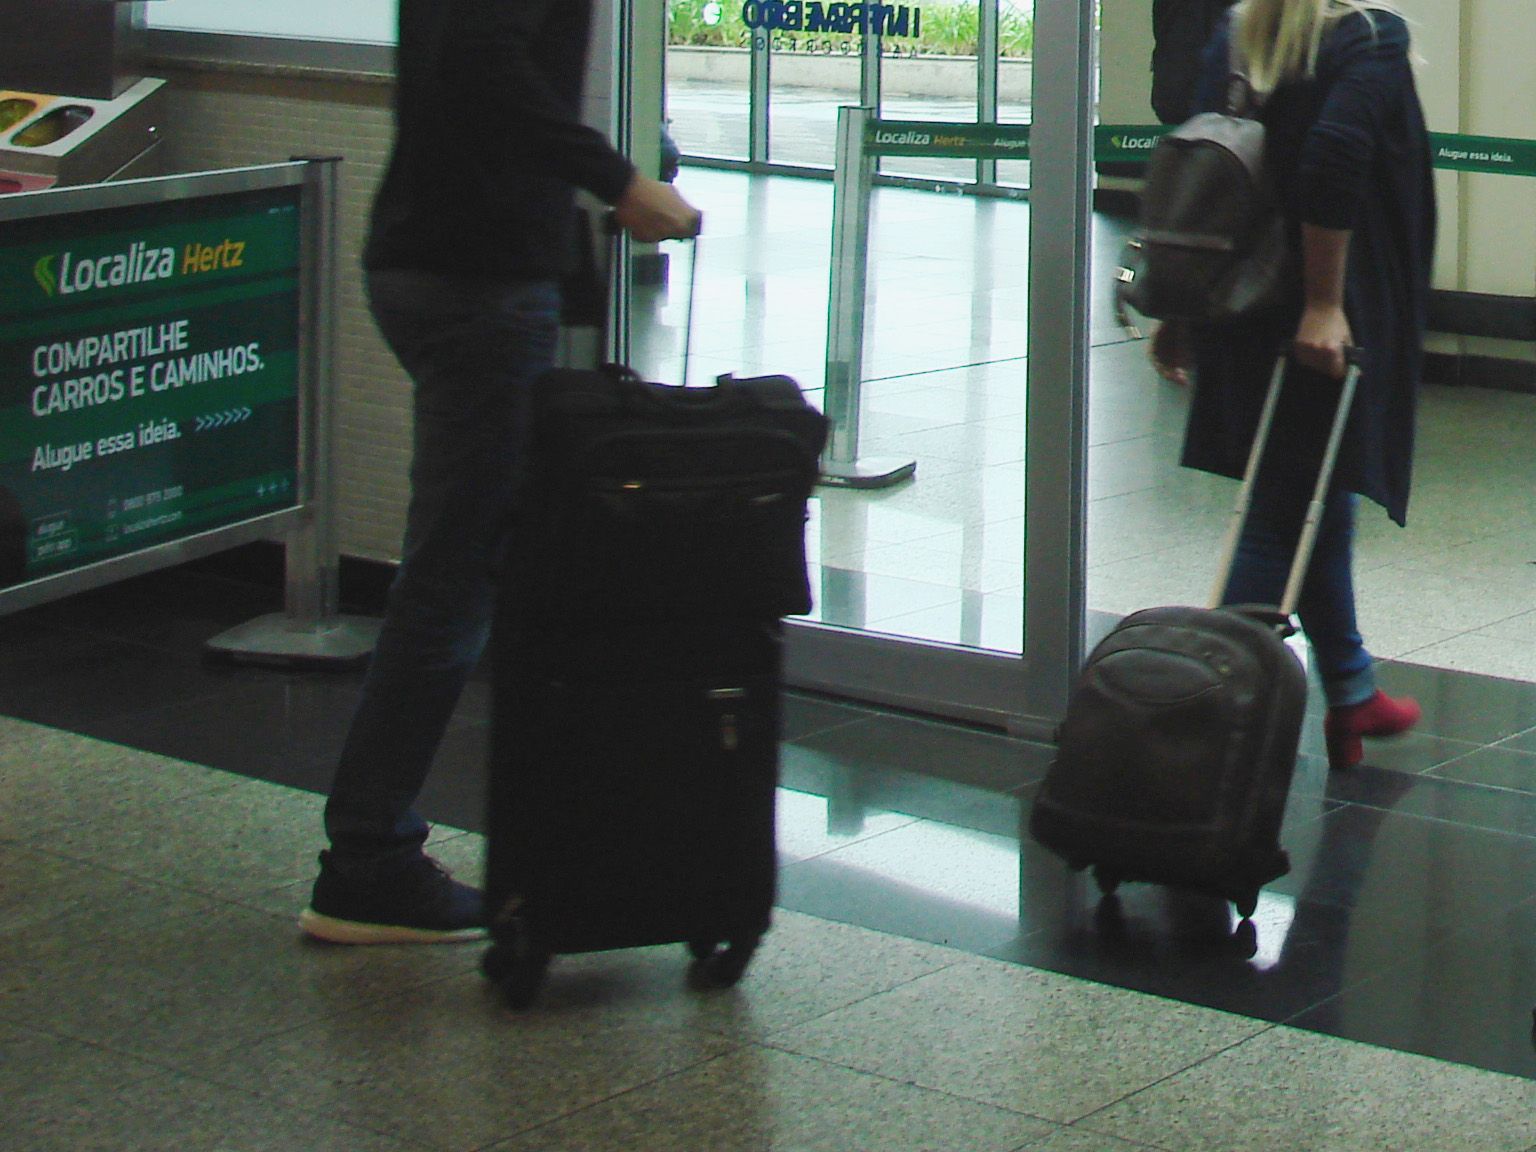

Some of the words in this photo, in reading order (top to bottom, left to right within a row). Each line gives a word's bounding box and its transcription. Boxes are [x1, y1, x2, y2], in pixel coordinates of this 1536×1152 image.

[875, 130, 930, 145] Localiza
[933, 134, 965, 147] Hertz
[1121, 135, 1160, 149] Locali
[1438, 147, 1468, 160] Alugue
[1469, 150, 1489, 161] essa
[1490, 151, 1513, 163] ideia.
[60, 241, 175, 294] Localiza
[181, 239, 246, 275] Hertz
[33, 319, 189, 377] COMPARTILHE
[32, 369, 125, 417] CARROS
[130, 365, 145, 397] E
[150, 342, 265, 393] CAMINHOS.
[32, 441, 93, 472] Alugue
[98, 431, 135, 456] essa
[138, 418, 182, 447] ideia.
